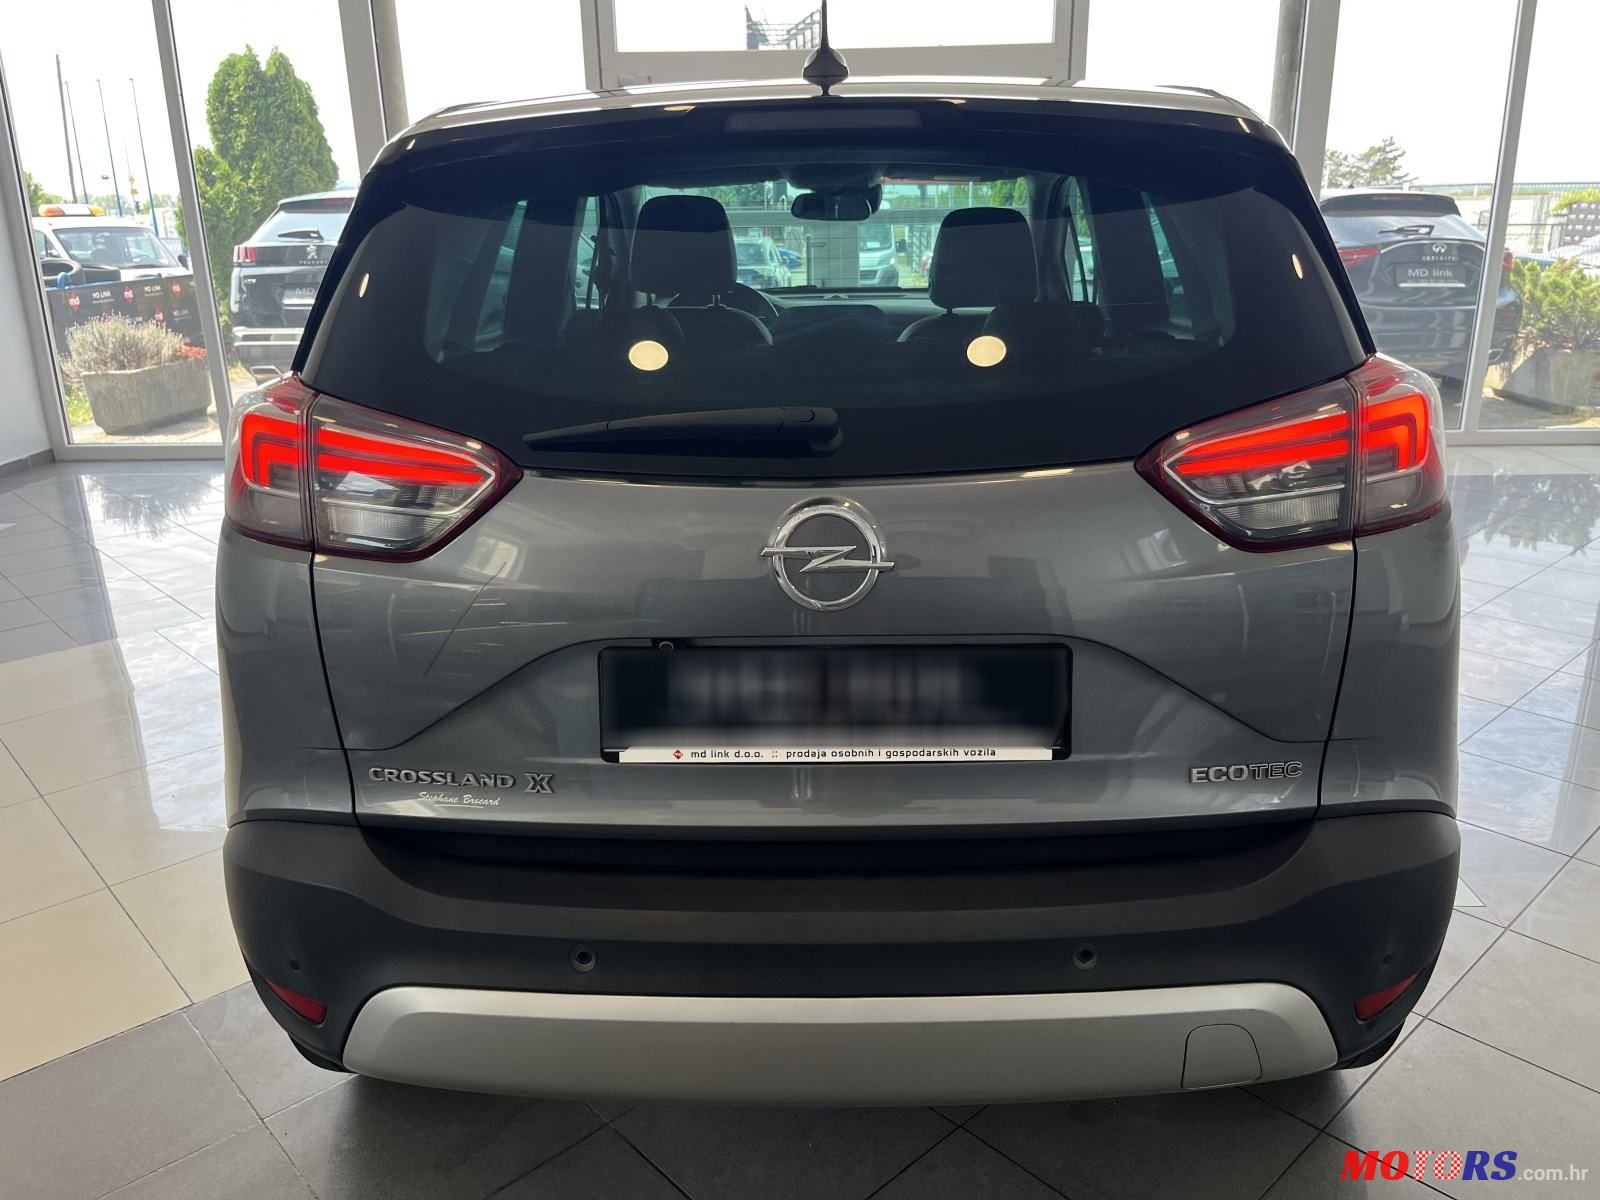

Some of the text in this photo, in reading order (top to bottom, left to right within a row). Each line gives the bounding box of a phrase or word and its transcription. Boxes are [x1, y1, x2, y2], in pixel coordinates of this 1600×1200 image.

[1408, 268, 1453, 277] MD link
[690, 749, 707, 758] md
[710, 749, 730, 758] link
[734, 749, 764, 758] d.o.o.
[786, 749, 827, 760] prodaja
[831, 748, 874, 757] osobnih
[886, 748, 959, 759] gospodarskih
[963, 747, 996, 757] vozila
[368, 767, 554, 794] CROSSLAND X
[1190, 761, 1303, 783] ECOTEC
